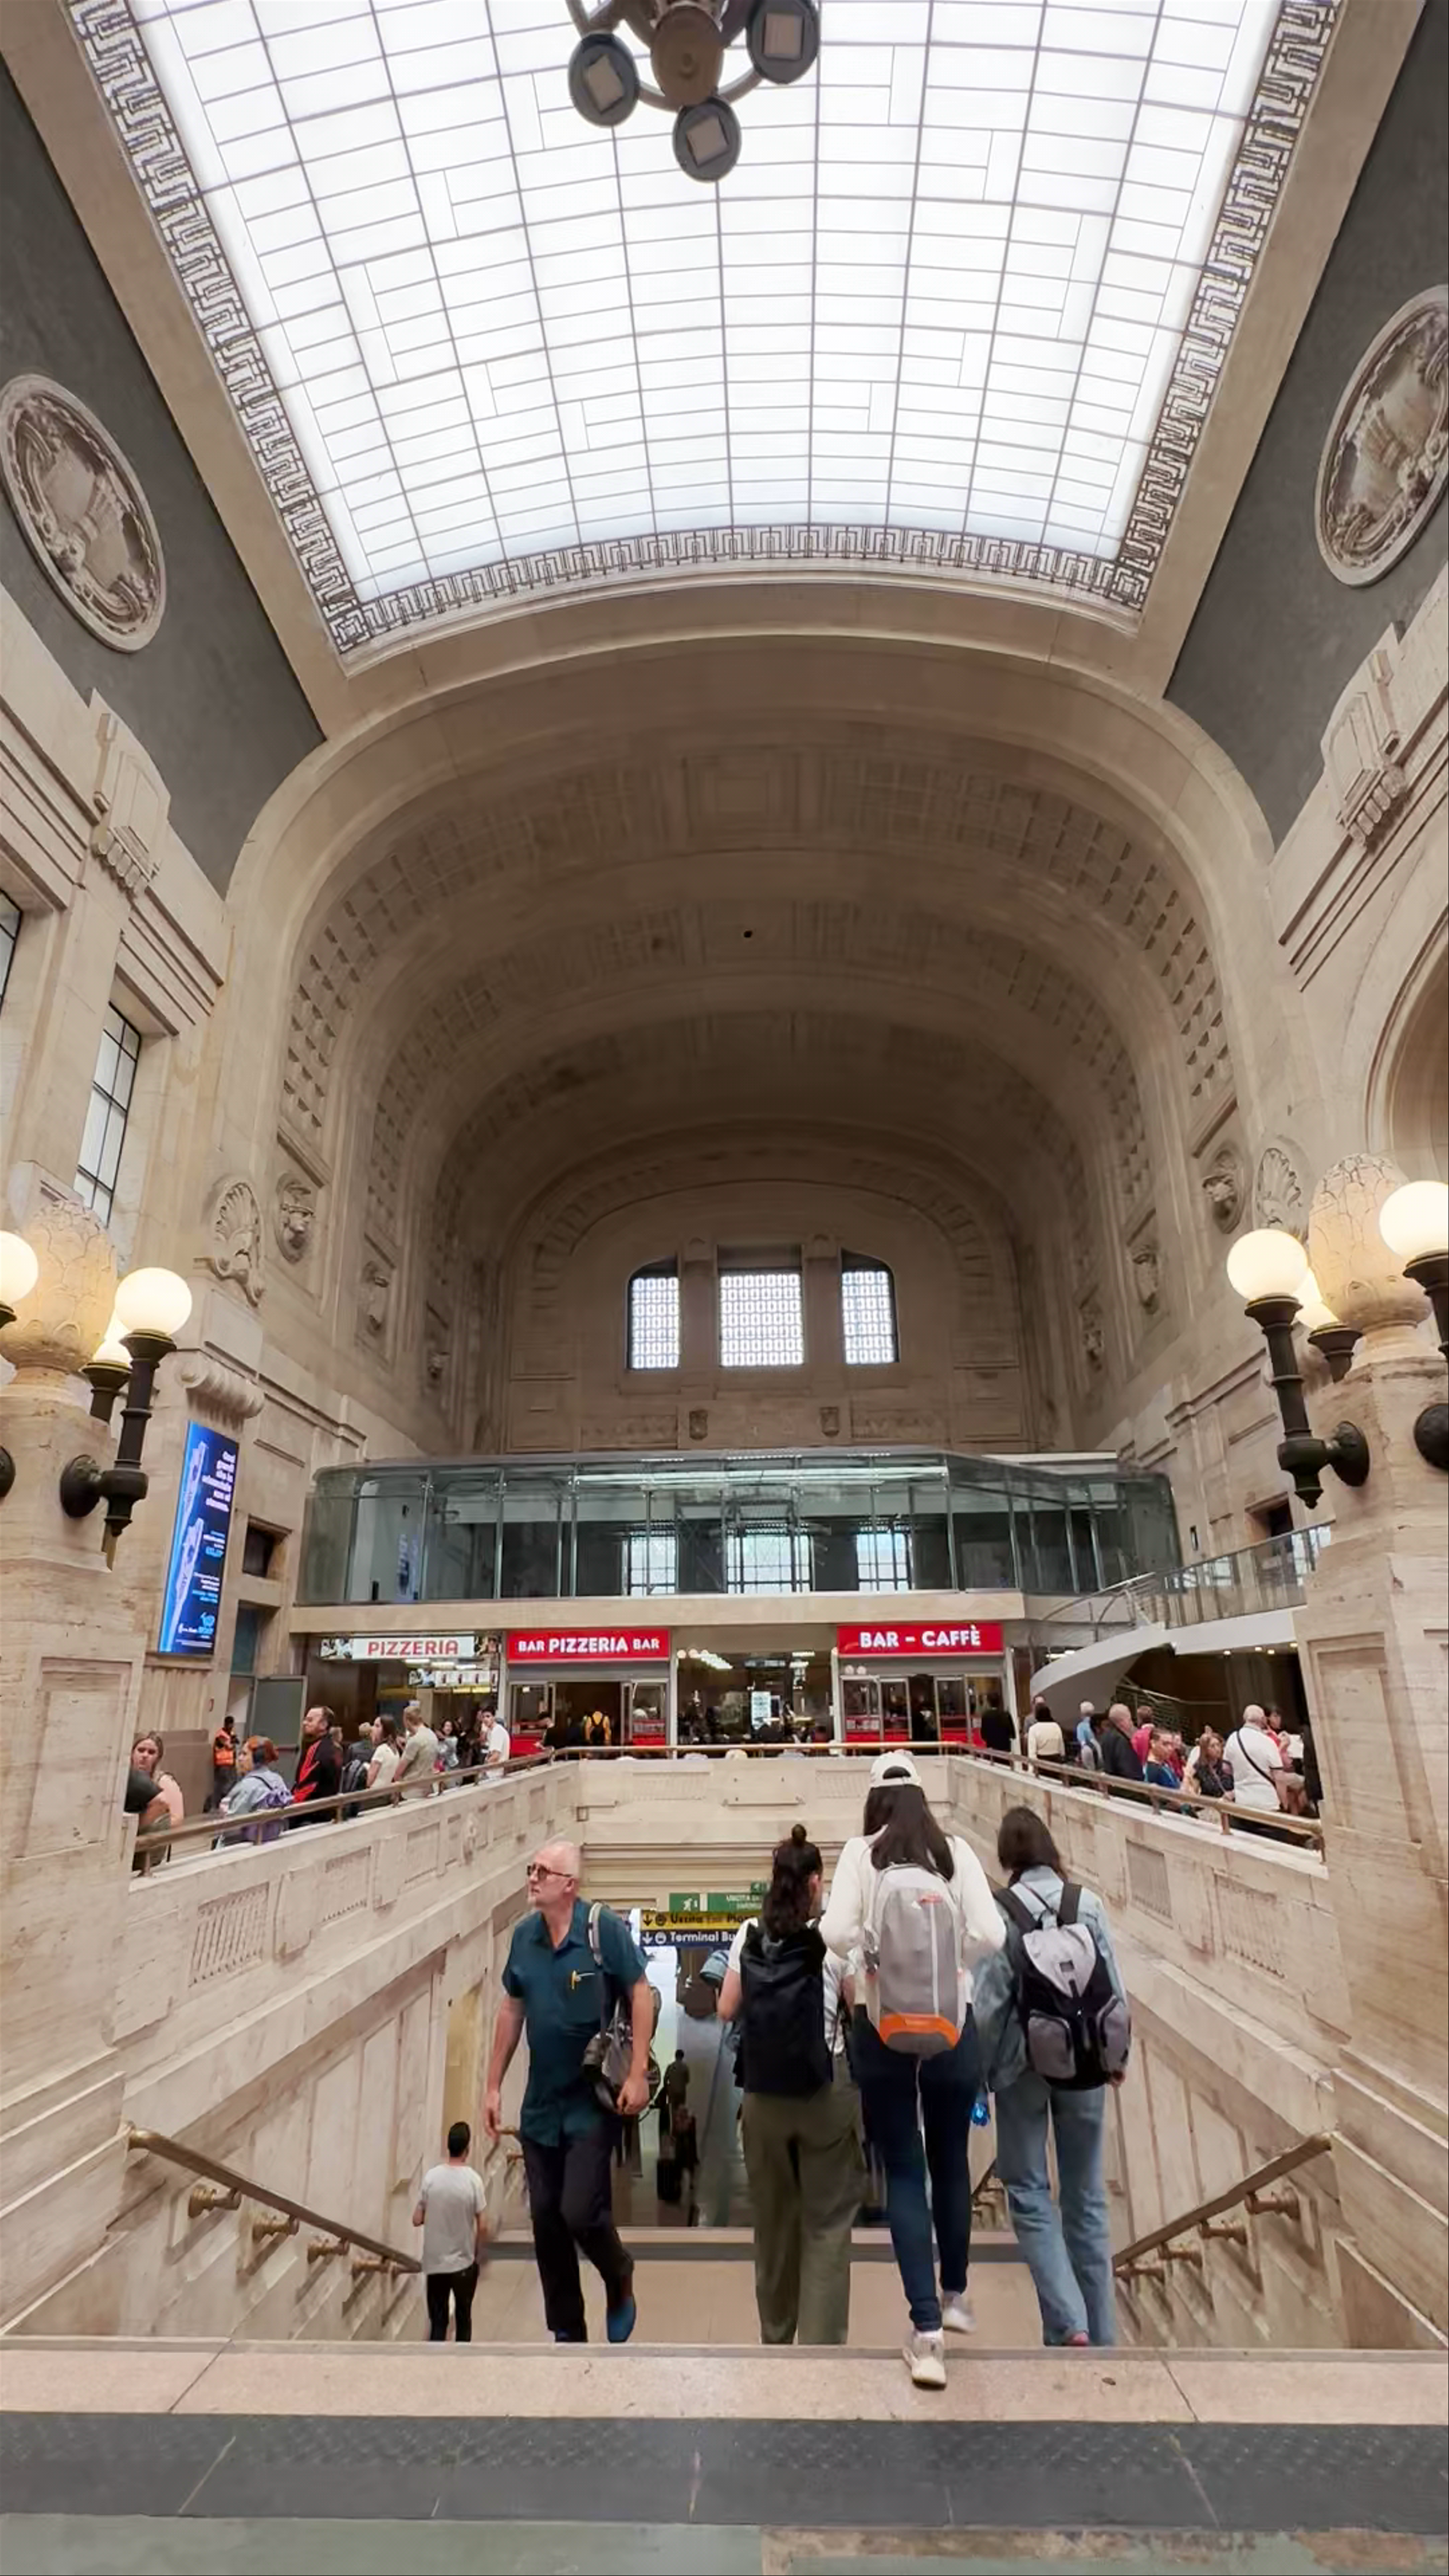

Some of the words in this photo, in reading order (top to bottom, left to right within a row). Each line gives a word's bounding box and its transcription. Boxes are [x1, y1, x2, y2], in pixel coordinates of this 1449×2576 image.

[860, 1632, 899, 1648] BAR
[922, 1624, 981, 1647] CAFFÈ
[368, 1640, 458, 1656] PIZZERIA
[518, 1640, 545, 1652] BAR
[549, 1637, 628, 1653] PIZZERIA
[632, 1638, 660, 1650] BAR
[670, 1931, 719, 1942] Terminal
